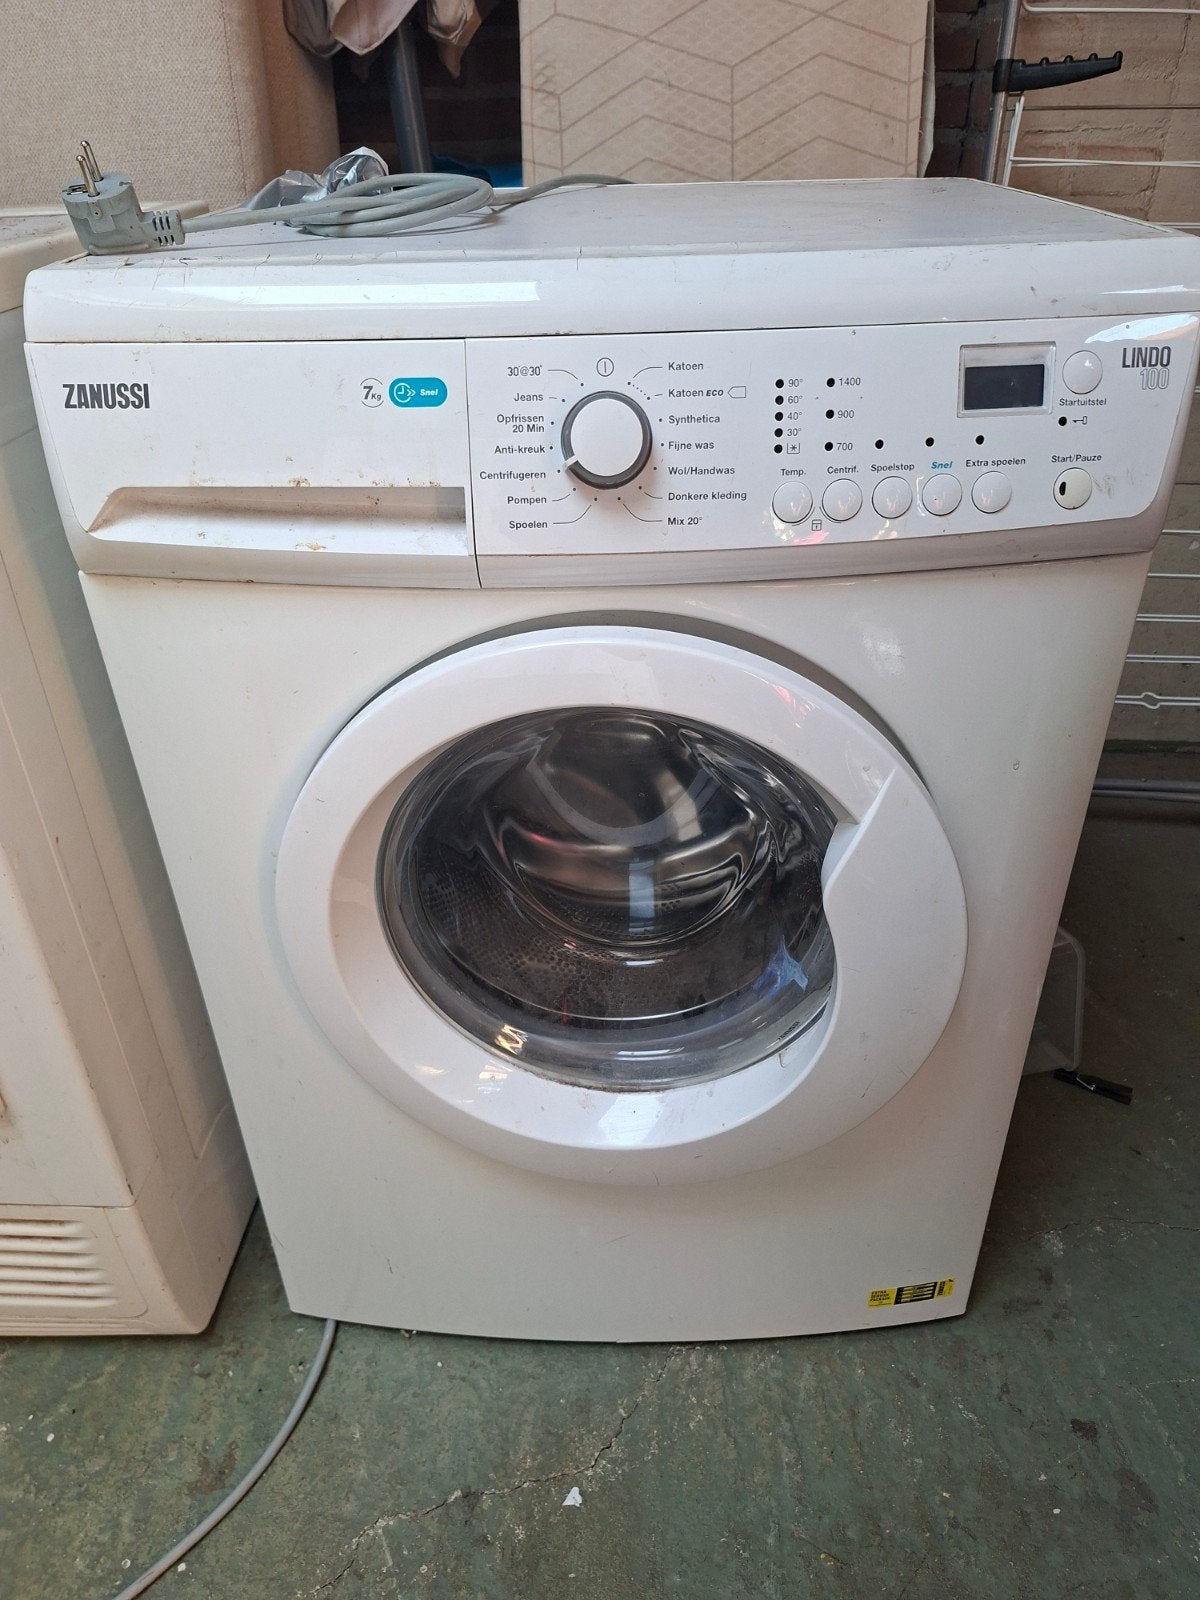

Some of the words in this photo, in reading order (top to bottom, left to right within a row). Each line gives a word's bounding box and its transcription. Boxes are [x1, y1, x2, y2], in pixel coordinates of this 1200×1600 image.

[1121, 345, 1172, 369] LINDO
[668, 362, 704, 371] Katoen
[788, 378, 803, 388] 90°
[839, 377, 861, 386] 1400
[1139, 367, 1170, 390] 100
[62, 383, 150, 409] ZANUSSI
[420, 388, 439, 396] Snel
[668, 388, 704, 398] Katoen
[705, 389, 724, 397] ECO
[513, 393, 544, 402] Jeans
[787, 395, 803, 404] 60°
[1059, 397, 1107, 407] Startuitstel
[787, 411, 803, 420] 40°
[837, 409, 855, 418] 900
[496, 414, 545, 425] Opfrissen
[668, 414, 721, 426] Synthetica
[512, 424, 524, 433] 20
[526, 424, 545, 433] Min
[786, 427, 802, 437] 30°
[494, 445, 546, 454] Anti-kreuk
[668, 440, 692, 451] Fijne
[695, 442, 715, 450] was
[836, 442, 853, 451] 700
[965, 459, 989, 468] Extra
[991, 457, 1026, 468] spoelen
[1051, 454, 1102, 463] Start/Pauze
[668, 465, 736, 475] Wol/Handwas
[826, 465, 859, 475] Centrif.
[870, 462, 915, 473] Spoelstop
[931, 460, 953, 470] Snel
[479, 471, 547, 481] Centrifugeren
[780, 468, 807, 477] Temp.
[668, 491, 709, 501] Donkere
[711, 489, 747, 501] kleding
[507, 495, 548, 506] Pompen
[508, 520, 548, 530] Spoelen
[667, 516, 685, 526] Mix
[687, 516, 703, 526] 20°
